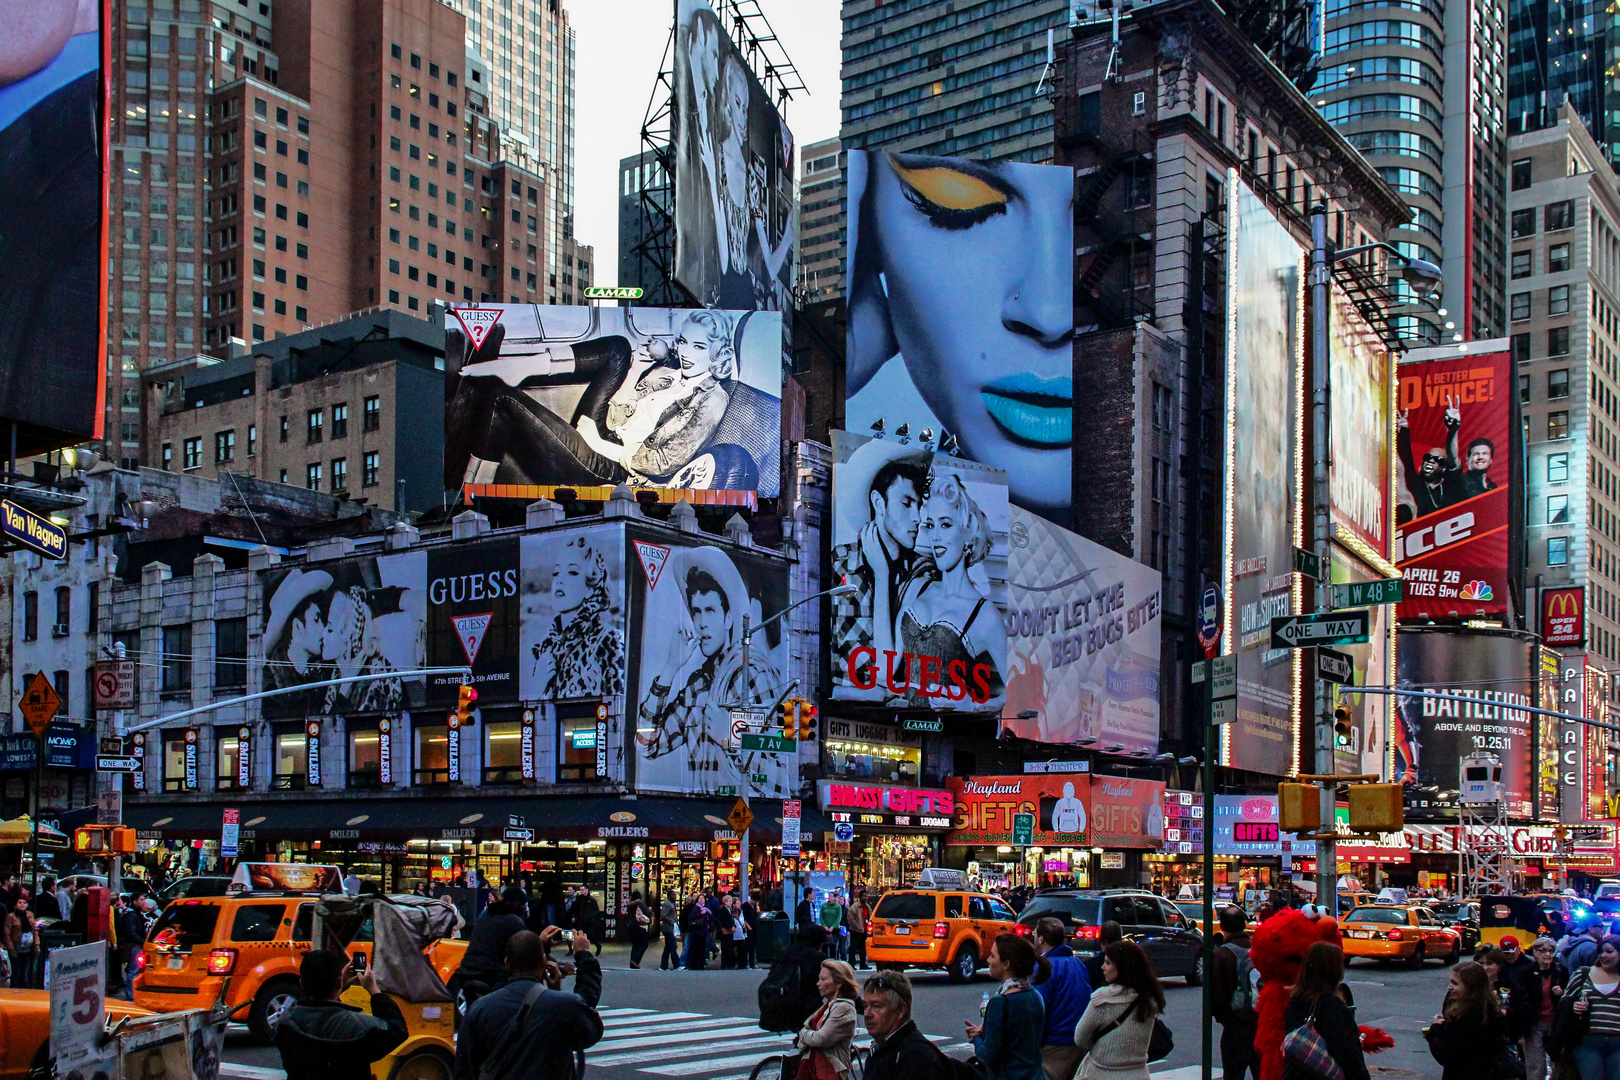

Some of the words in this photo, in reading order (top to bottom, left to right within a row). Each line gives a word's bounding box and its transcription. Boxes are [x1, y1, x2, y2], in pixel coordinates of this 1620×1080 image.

[589, 287, 638, 298] LAMAR
[461, 311, 495, 321] GUESS
[1426, 374, 1432, 385] A
[1434, 370, 1468, 384] BETTER
[1425, 379, 1494, 407] VOICE!
[5, 506, 25, 532] Van
[27, 520, 64, 551] Wagner
[640, 546, 665, 560] GUESS
[1403, 568, 1439, 582] APRIL
[1442, 570, 1460, 583] 26
[429, 568, 517, 605] GUESS
[1352, 587, 1363, 603] W
[1367, 583, 1383, 601] 48
[1388, 580, 1399, 591] ST
[1409, 582, 1436, 596] TUES
[1007, 604, 1060, 637] DON'T
[1062, 594, 1092, 631] LET
[1098, 581, 1125, 617] THE
[457, 617, 486, 631] GUESS
[1241, 602, 1257, 633] HOW
[1286, 624, 1312, 638] ONE
[1326, 621, 1356, 635] WAY
[1553, 624, 1573, 634] 24
[1051, 630, 1083, 669] BED
[1086, 613, 1124, 655] BUGS
[1547, 634, 1579, 642] HOURS
[848, 645, 991, 704] GUESS
[1322, 659, 1334, 672] ONE
[1337, 661, 1350, 676] WAY
[434, 677, 447, 685] 47th
[476, 675, 485, 683] 5th
[486, 672, 510, 682] AVENUE
[830, 720, 850, 738] GIFTS
[855, 724, 888, 741] LUGGAGE
[906, 721, 939, 731] LAMAR
[1434, 723, 1463, 731] ABOVE
[1465, 724, 1481, 732] AND
[1483, 724, 1508, 733] BEYOND
[1509, 727, 1518, 735] THE
[1564, 668, 1576, 786] PALACE
[48, 736, 77, 746] MOMO
[574, 732, 596, 740] INTERNET
[758, 737, 765, 748] 7
[767, 738, 782, 749] Av
[1471, 736, 1511, 750] 10.25.11
[449, 730, 459, 781] SMILER'S
[522, 726, 533, 779] SMILER'S
[597, 721, 607, 777] SMILER'S
[7, 754, 30, 762] LOWEST
[186, 744, 197, 788] SMILER'S
[238, 741, 249, 786] SMILER'S
[309, 738, 319, 785] SMILER'S
[380, 734, 390, 784] SMILER'S
[963, 780, 1022, 798] Playland
[1101, 781, 1134, 800] Playland
[830, 784, 884, 809] EMBASSY
[889, 788, 954, 814] GIFTS
[1181, 795, 1191, 804] NYC
[954, 801, 1037, 831] GIFTS
[1092, 803, 1140, 833] GIFTS
[1193, 807, 1202, 817] NYC
[920, 816, 950, 827] LUGGAGE
[137, 830, 162, 839] SMILER'S
[329, 830, 360, 839] SMILER'S
[442, 828, 476, 839] SMILER'S
[597, 826, 649, 837] SMILER'S
[1033, 833, 1046, 842] ATS
[1051, 833, 1086, 842] LUGGAGE
[1170, 830, 1179, 840] NYC
[1236, 823, 1278, 840] GIFTS
[677, 841, 706, 851] INTERNET
[1181, 843, 1191, 853] NYC
[606, 861, 616, 915] SMILER'S
[620, 861, 629, 915] SMILER'S
[72, 973, 100, 1025] 5
